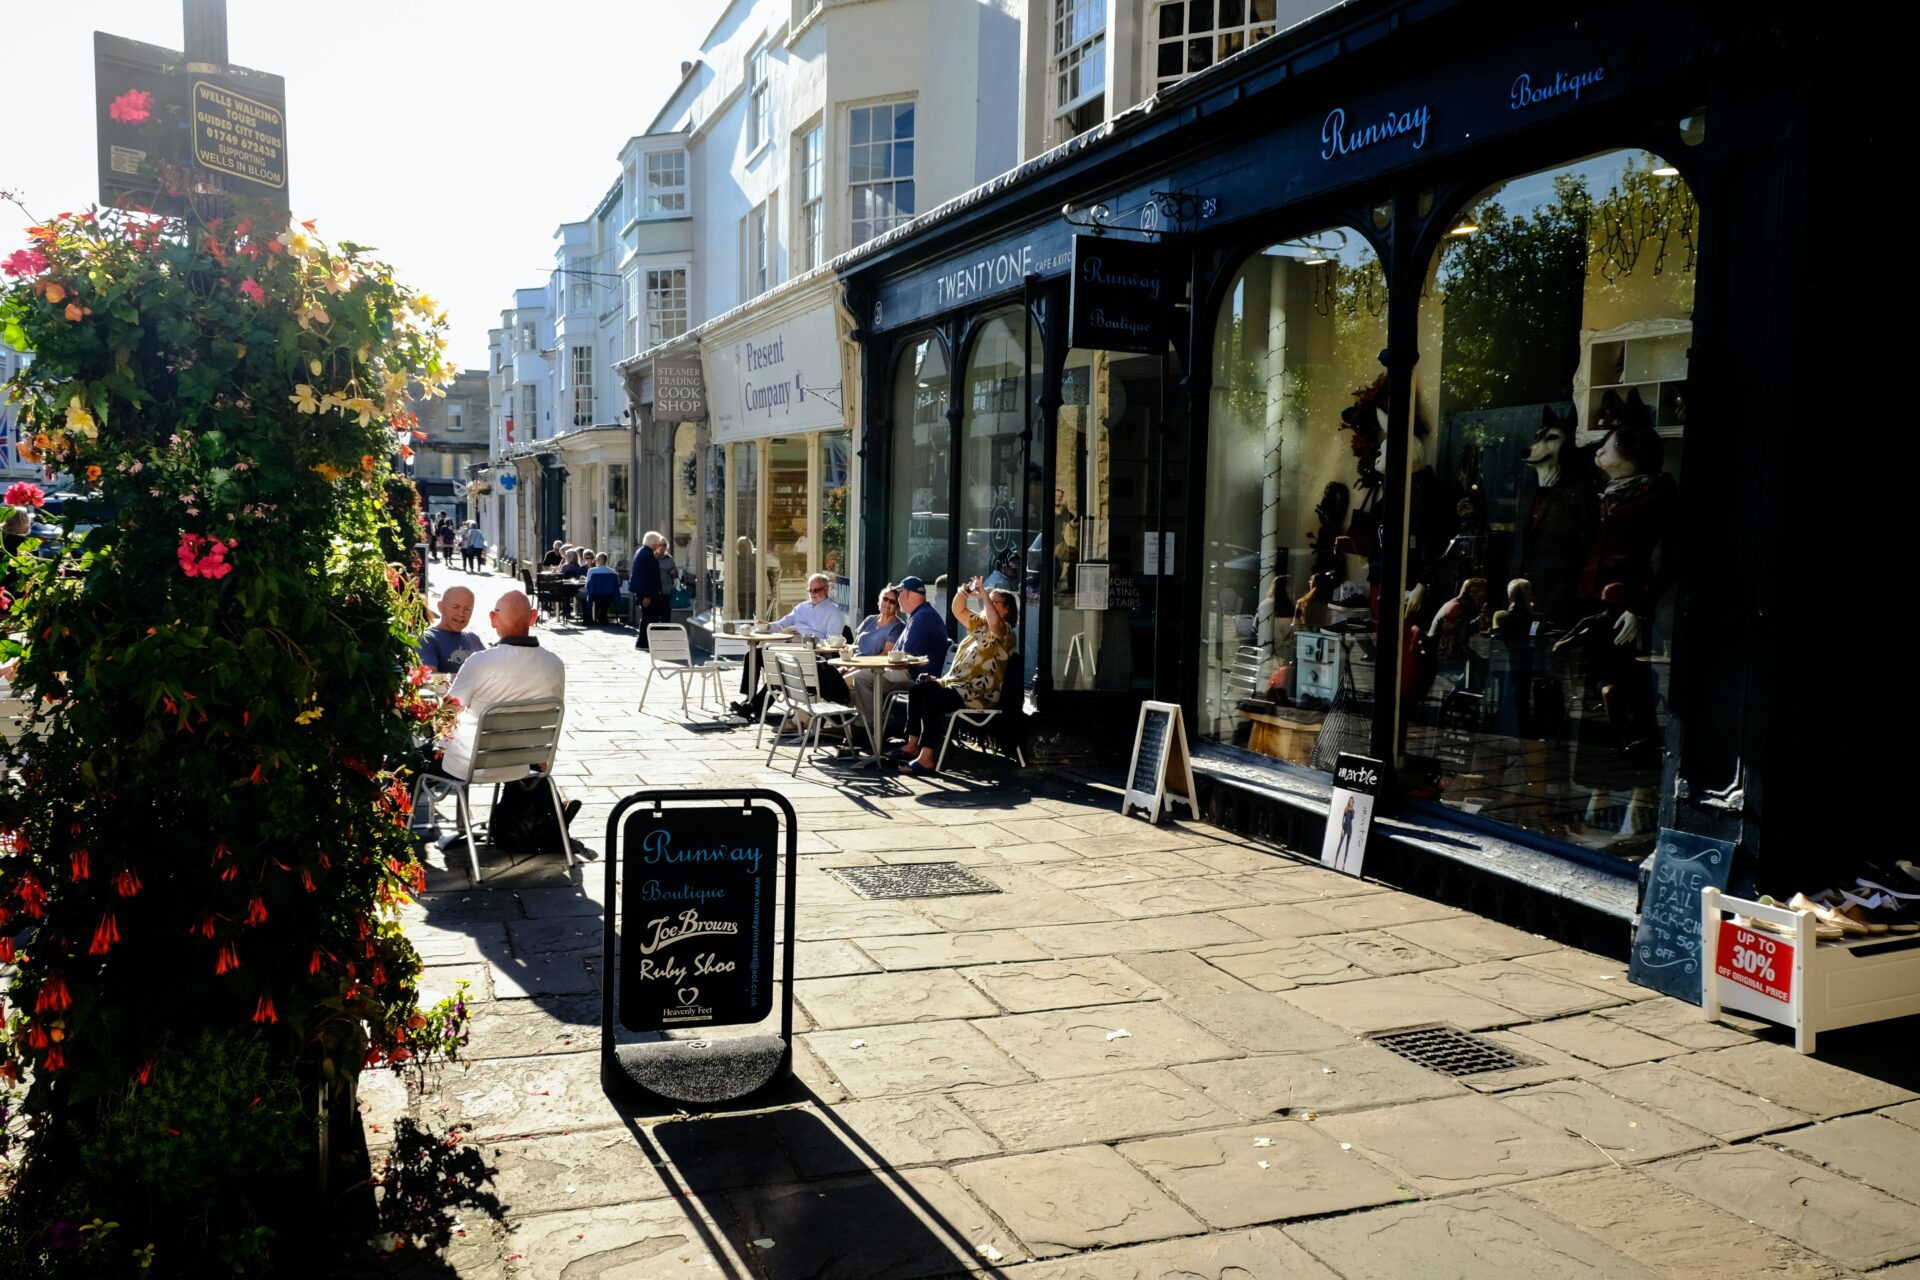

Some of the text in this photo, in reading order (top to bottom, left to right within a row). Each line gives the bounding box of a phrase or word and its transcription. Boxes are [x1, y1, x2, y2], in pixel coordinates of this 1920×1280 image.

[199, 87, 280, 125] WELLS WALKING
[225, 109, 257, 128] TOURS
[1321, 67, 1605, 160] Runway Boutique
[197, 111, 281, 148] GUIDED CITY TOURS
[206, 127, 276, 159] 01749 672438
[218, 144, 266, 167] SUPPORTING
[200, 149, 281, 183] WELLS IN BLOOM
[1144, 209, 1155, 229] 21
[1202, 198, 1217, 219] 23
[937, 245, 1032, 305] TWENTYONE
[1034, 258, 1052, 273] CAFE
[1058, 251, 1072, 265] KITC
[1082, 256, 1162, 300] Runway
[1089, 308, 1152, 336] Boutique
[746, 333, 784, 372] Present
[657, 367, 700, 376] STEAMER
[658, 377, 700, 386] TRADING
[658, 387, 700, 399] COOK
[745, 381, 791, 418] Company
[658, 400, 701, 412] SHOP
[995, 517, 1006, 540] 21
[1108, 598, 1142, 609] STAIRS
[1338, 766, 1378, 785] marble
[642, 829, 763, 874] Runway
[1656, 863, 1702, 891] SALE
[641, 879, 726, 904] Boutique
[1658, 886, 1693, 910] RAIL
[1655, 927, 1671, 939] TO
[1736, 930, 1776, 955] UP TO
[1655, 947, 1677, 960] OFF
[1731, 945, 1776, 982] 30%
[640, 952, 736, 985] Ruby Shoo
[1718, 965, 1789, 1001] OFF ORIGINAL PRICE
[663, 1006, 713, 1016] Heavenly Feet
